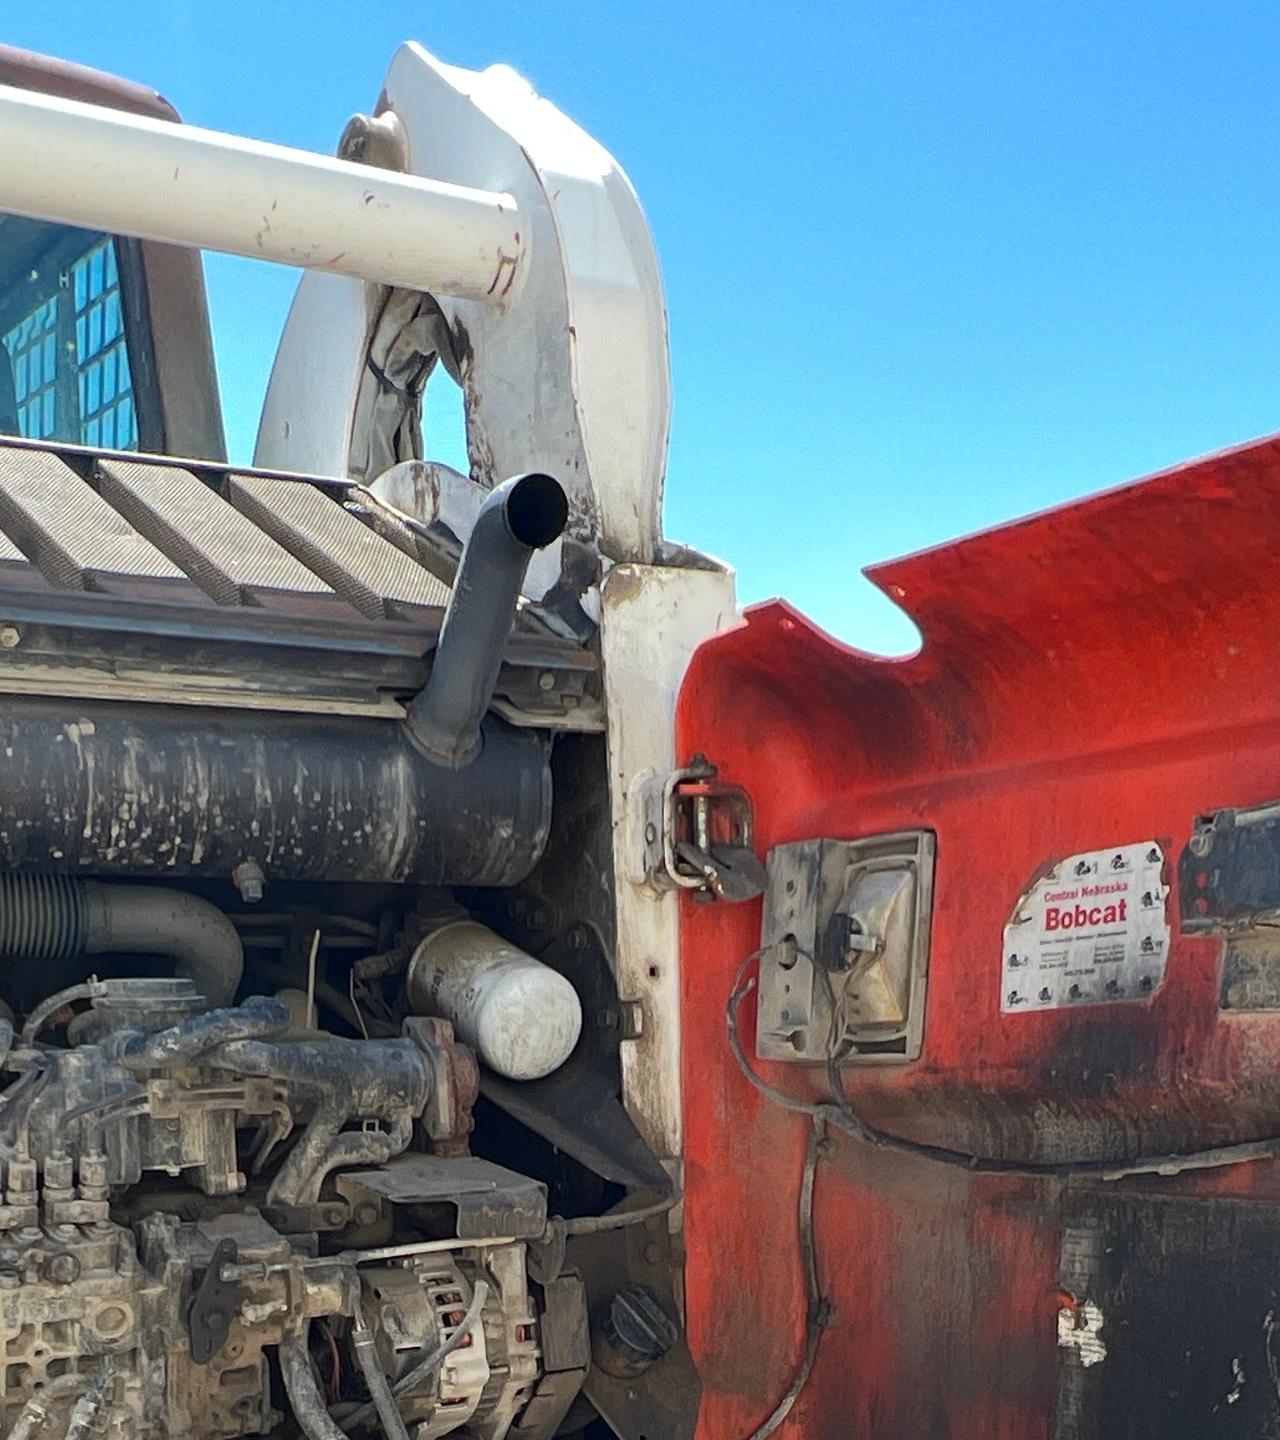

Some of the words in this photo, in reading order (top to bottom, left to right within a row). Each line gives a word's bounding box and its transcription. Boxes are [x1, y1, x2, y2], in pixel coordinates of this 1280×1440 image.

[1044, 887, 1079, 902] Central
[1081, 880, 1128, 898] Nebraska
[1045, 898, 1128, 932] Bobcat
